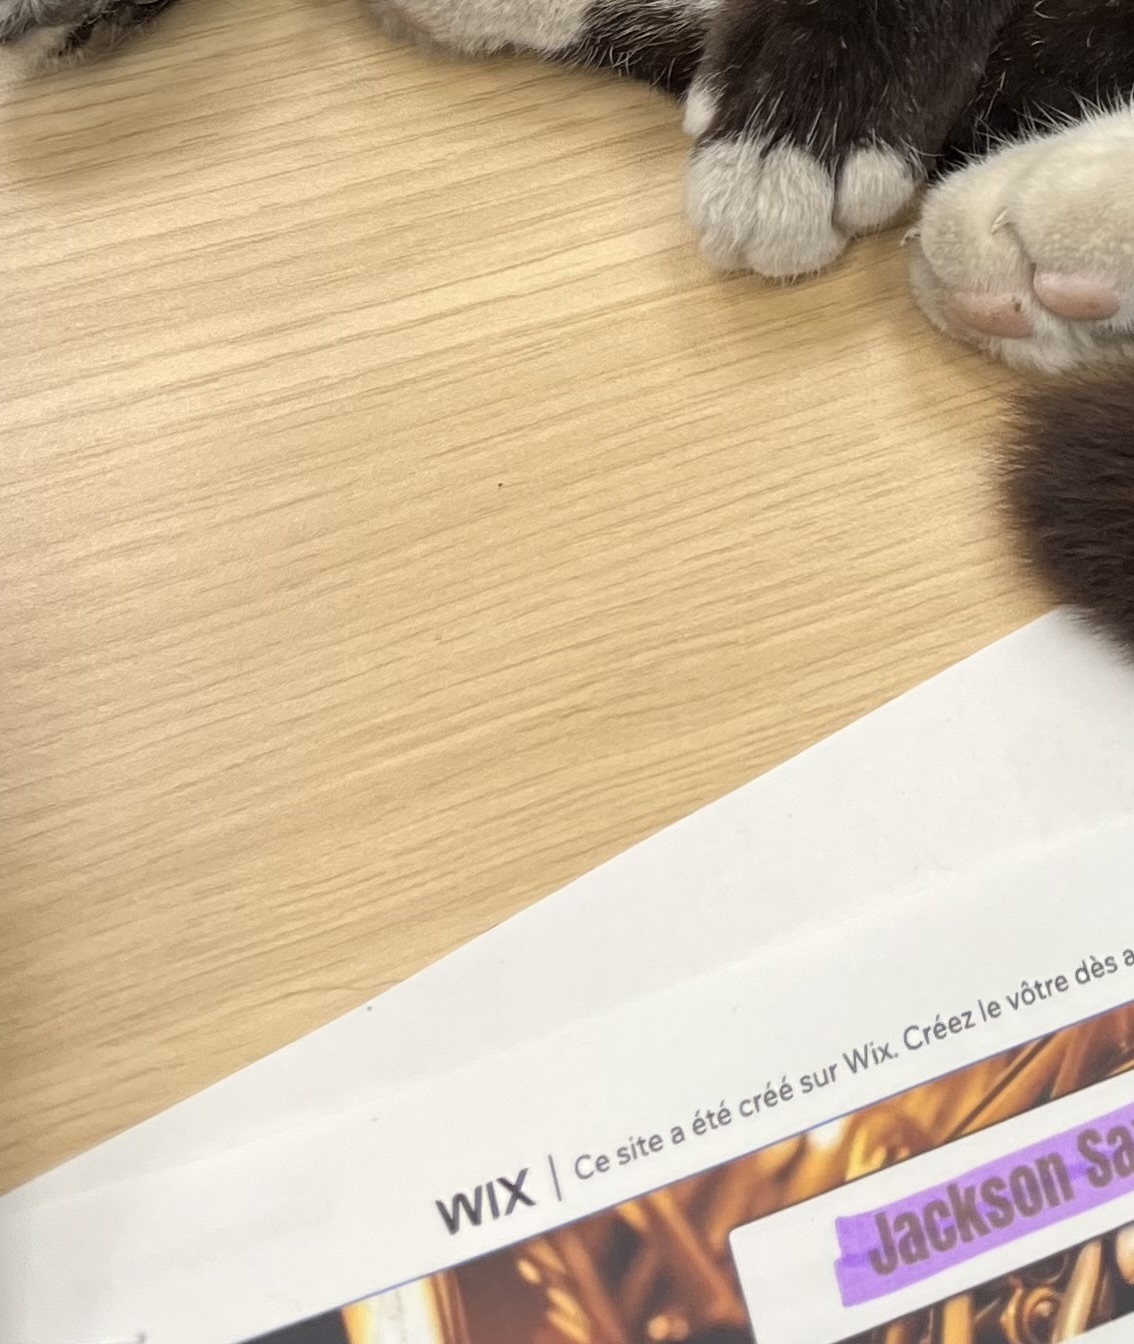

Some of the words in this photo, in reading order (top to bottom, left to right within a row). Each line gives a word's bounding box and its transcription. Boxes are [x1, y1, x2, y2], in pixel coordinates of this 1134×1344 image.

[574, 1154, 610, 1180] Ce
[616, 1136, 663, 1165] site
[670, 1125, 686, 1144] a
[692, 1100, 732, 1135] été
[739, 1076, 794, 1117] créé
[799, 1063, 838, 1093] sur
[843, 1042, 899, 1074] Wix.
[903, 1014, 976, 1050] Créez
[978, 999, 1001, 1022] le
[1006, 974, 1069, 1011] vôtre
[1075, 954, 1118, 985] dès
[435, 1167, 536, 1235] WIX
[867, 1151, 1075, 1276] Jackson
